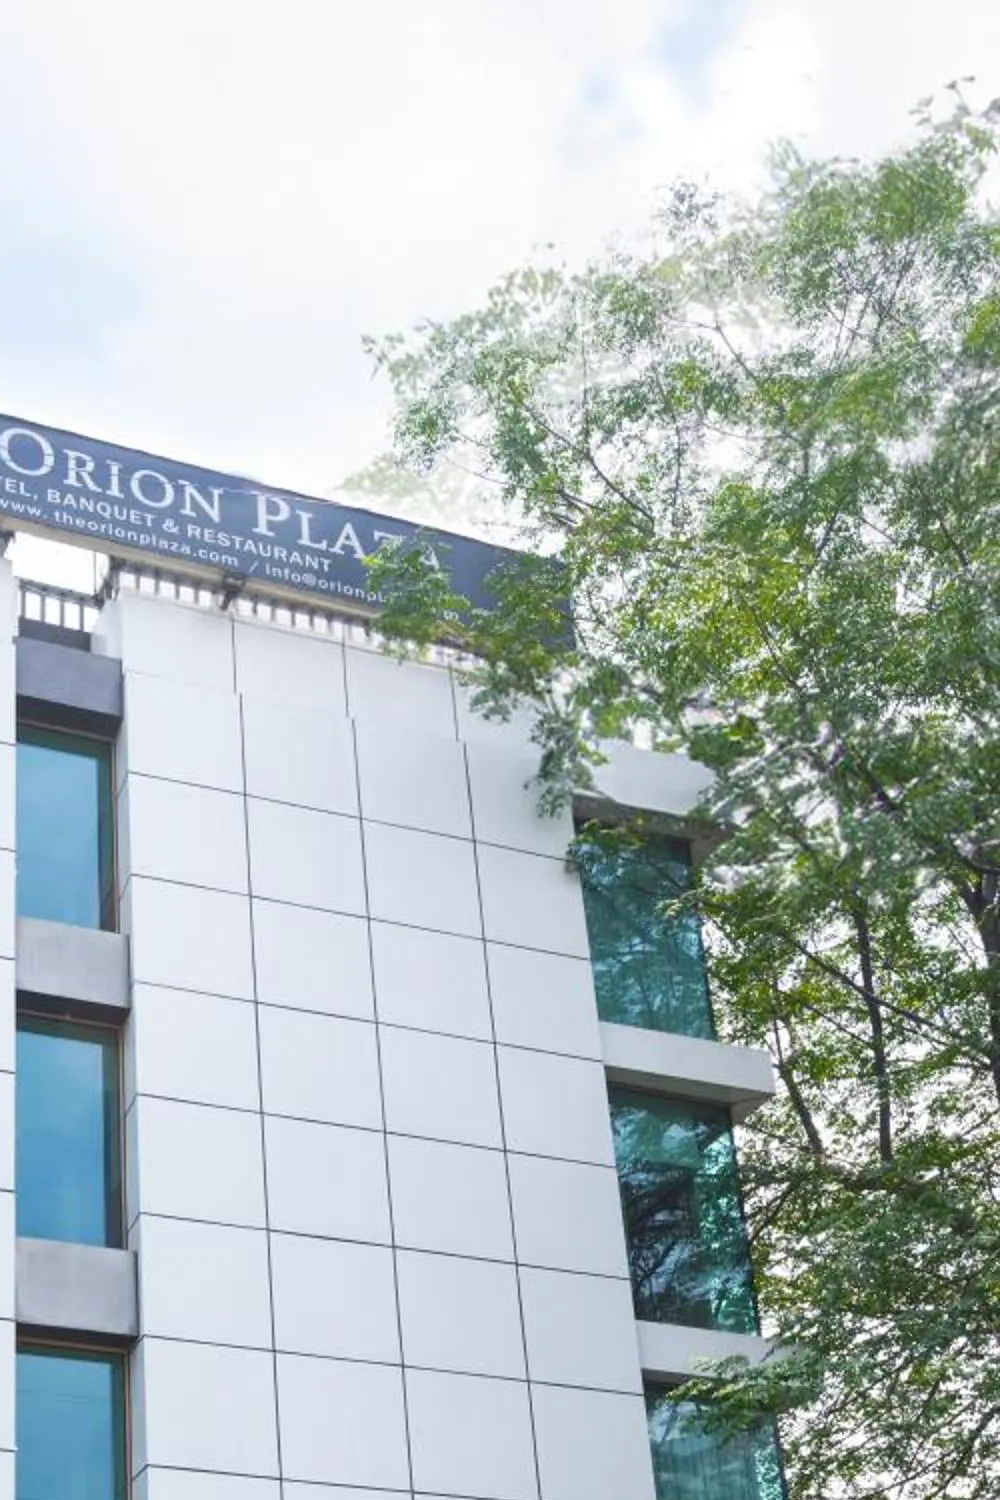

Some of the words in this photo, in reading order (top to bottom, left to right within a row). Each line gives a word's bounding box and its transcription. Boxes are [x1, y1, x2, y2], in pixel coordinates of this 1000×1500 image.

[46, 489, 154, 528] BANQUET
[161, 517, 181, 534] &
[186, 523, 333, 573] RESTAURANT
